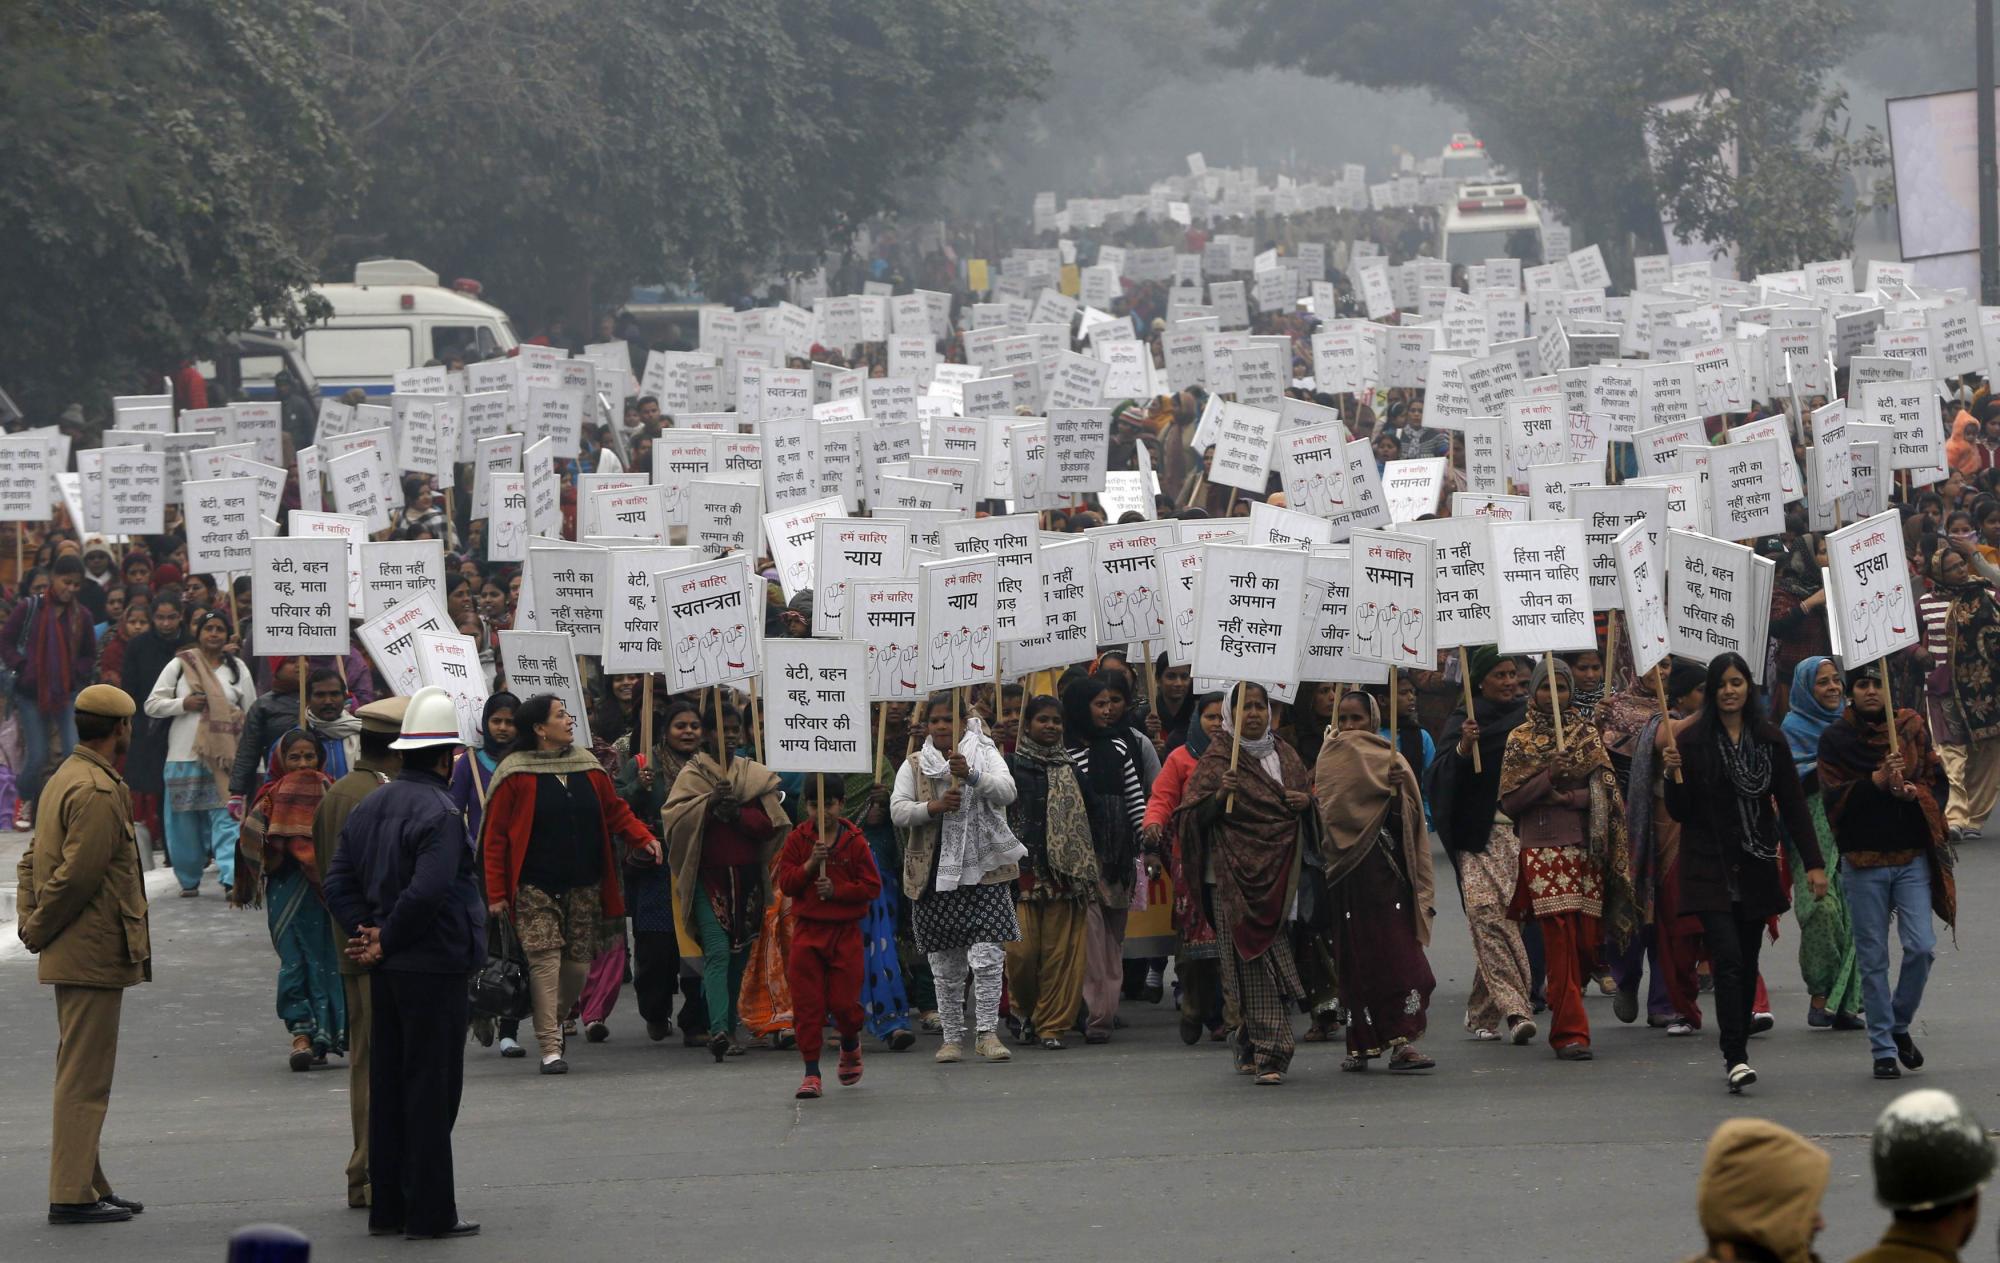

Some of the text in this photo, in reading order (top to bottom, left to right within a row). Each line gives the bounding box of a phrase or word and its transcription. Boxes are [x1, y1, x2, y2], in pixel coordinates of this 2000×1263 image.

[1706, 347, 1724, 356] चाहिए
[1696, 359, 1728, 372] सम्मान
[1653, 378, 1668, 387] नारी
[1655, 389, 1680, 397] अपमान
[1532, 405, 1551, 413] चाहिए
[1877, 396, 1920, 408] बेटी, बहन
[1899, 412, 1919, 420] माता
[1056, 419, 1102, 431] चाहिए गरिमा
[1252, 425, 1264, 435] नहीं
[1522, 420, 1551, 436] सुरक्षा
[1224, 432, 1268, 449] सम्मान चाहिए
[1307, 434, 1326, 444] चाहिए
[1666, 432, 1688, 442] चाहिए
[1912, 428, 1923, 438] की
[944, 439, 976, 450] सम्मान
[1900, 444, 1928, 454] विधाता
[725, 456, 762, 470] प्रतिष्ठा
[1292, 448, 1331, 464] सम्मान
[488, 458, 512, 470] सम्मान
[670, 462, 708, 472] सम्मान
[1729, 462, 1762, 474] नारी का
[1390, 478, 1432, 488] समानता
[1732, 475, 1762, 488] अपमान
[224, 498, 244, 507] बहन
[1727, 492, 1770, 508] नहीं सहेगा
[704, 503, 742, 514] भारत की
[224, 514, 244, 522] माता
[616, 511, 646, 523] न्याय
[714, 515, 732, 526] नारी
[1592, 512, 1619, 528] हिंसा
[327, 524, 350, 535] चाहिए
[840, 531, 887, 544] हमें चाहिए
[954, 533, 1027, 552] चाहिए गरिमा
[1109, 536, 1157, 551] हमें चाहिए
[1850, 533, 1886, 554] हमें चाहिए
[1368, 546, 1411, 562] हमें चाहिए
[1450, 542, 1471, 558] नहीं
[1514, 545, 1565, 564] हिंसा नहीं
[272, 558, 328, 574] बेटी, बहन
[844, 551, 882, 566] न्याय
[379, 561, 424, 576] हिंसा नहीं
[552, 569, 593, 582] नारी का
[1053, 567, 1073, 583] नहीं
[1451, 560, 1484, 576] चाहिए
[1504, 564, 1579, 582] सम्मान चाहिए
[1685, 556, 1734, 582] बेटी, बहन
[1854, 553, 1888, 586] सुरक्षा
[370, 576, 435, 590] सम्मान चाहिए
[628, 571, 649, 587] बेटी,
[682, 575, 726, 593] हमें चाहिए
[945, 572, 982, 587] हमें चाहिए
[1230, 572, 1279, 590] नारी का
[1365, 567, 1414, 588] सम्मान
[274, 582, 326, 596] बहू, माता
[556, 588, 593, 598] अपमान
[870, 590, 913, 603] हमें चाहिए
[1052, 584, 1084, 600] चाहिए
[1462, 589, 1478, 600] का
[1686, 581, 1732, 602] बहू, माता
[628, 596, 646, 610] बहू,
[672, 589, 740, 618] स्वतन्त्रता
[948, 593, 978, 610] न्याय
[1230, 595, 1276, 609] अपमान
[1520, 591, 1572, 607] जीवन का
[270, 602, 331, 616] परिवार की
[550, 605, 602, 619] नहीं सहेगा
[1062, 611, 1076, 622] का
[1457, 604, 1490, 619] चाहिए
[1683, 604, 1734, 628] परिवार की
[382, 608, 422, 635] हमें चाहिए
[624, 617, 659, 632] परिवार
[867, 612, 915, 626] सम्मान
[1512, 609, 1584, 626] आधार चाहिए
[266, 622, 336, 636] भाग्य विधाता
[1055, 624, 1086, 640] चाहिए
[1218, 616, 1282, 636] नहीं सहेगा
[1679, 625, 1739, 650] भाग्य विधाता
[445, 645, 465, 657] चाहिए
[619, 642, 643, 652] भाग्य
[1309, 646, 1344, 656] आधार
[442, 662, 467, 678] न्याय
[518, 655, 557, 671] हिंसा नहीं
[785, 663, 847, 681] बेटी, बहन
[512, 672, 570, 688] सम्मान चाहिए
[788, 690, 845, 706] बहू, माता
[784, 714, 850, 730] परिवार की
[780, 736, 856, 752] भाग्य विधाता
